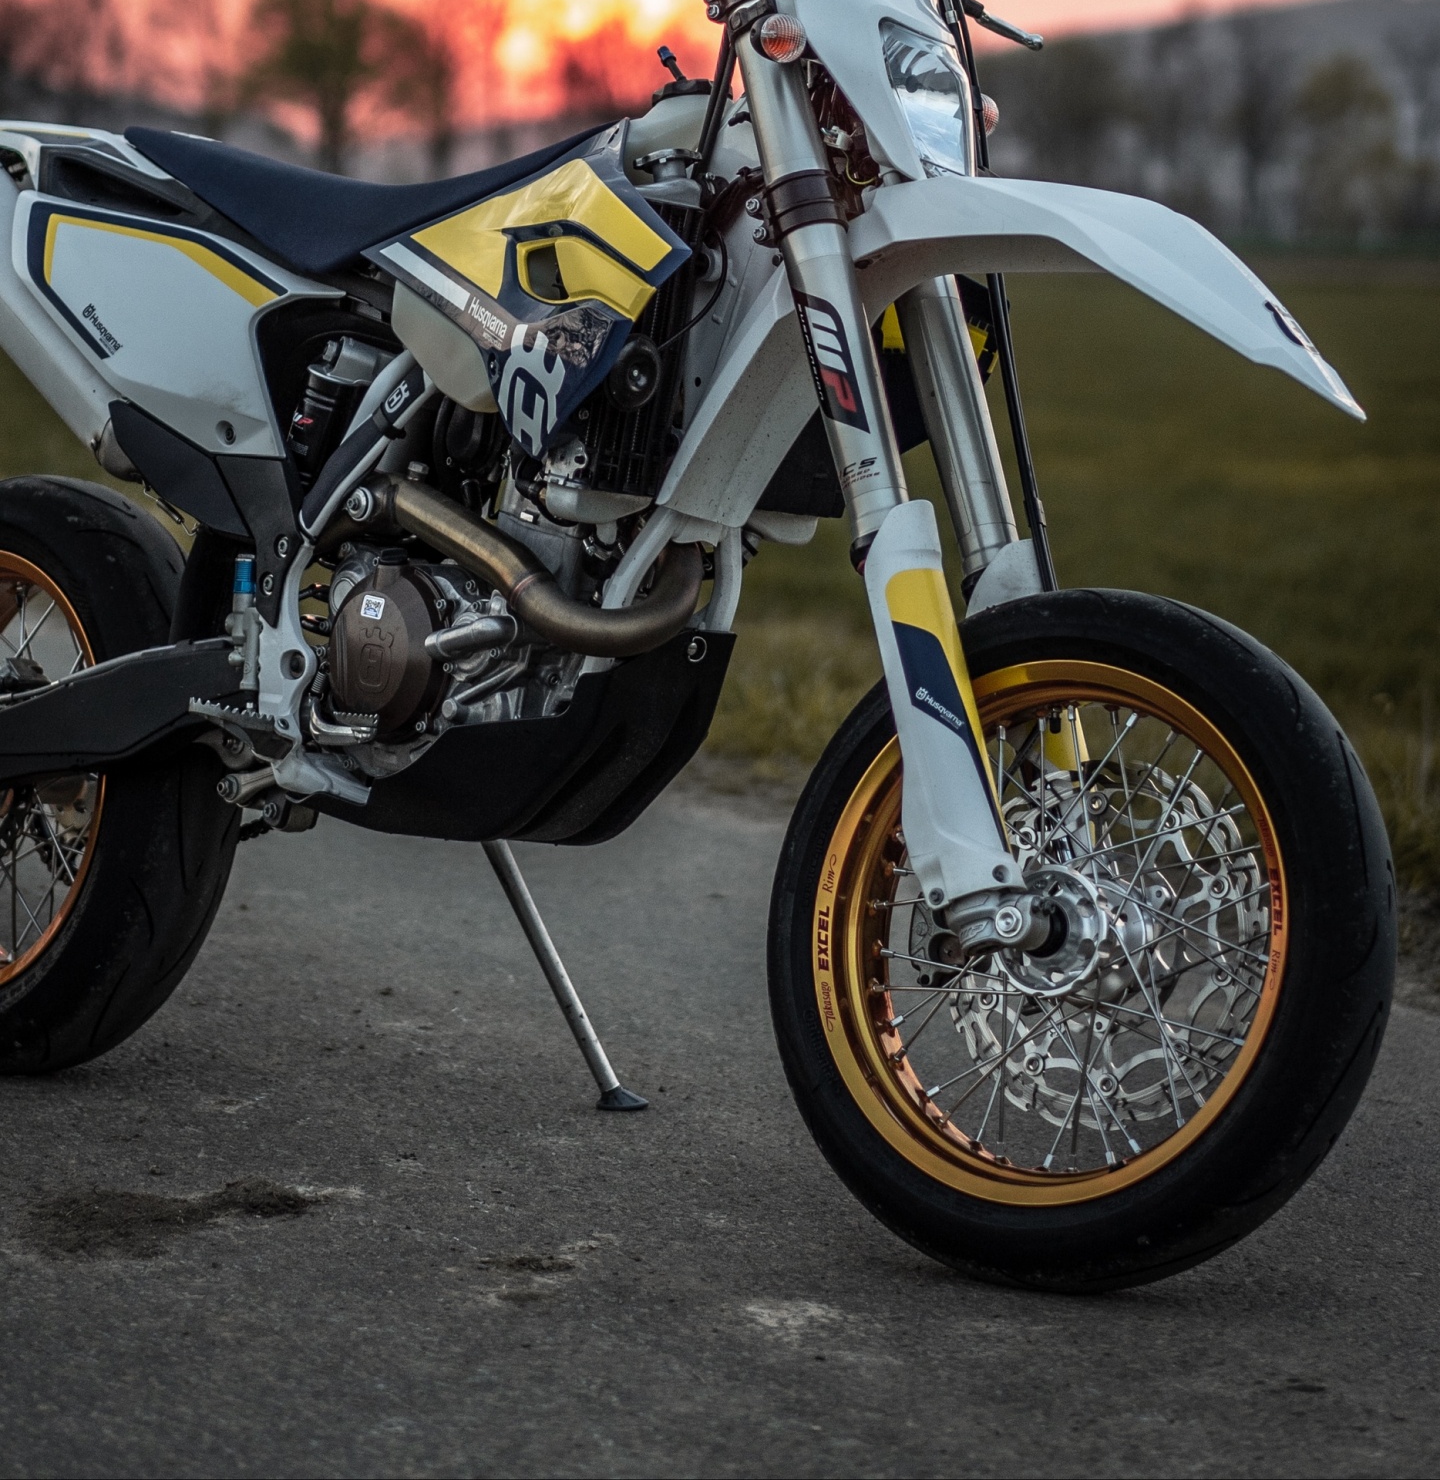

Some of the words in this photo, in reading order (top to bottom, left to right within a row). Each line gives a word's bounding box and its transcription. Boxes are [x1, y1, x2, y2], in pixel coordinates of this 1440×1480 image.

[89, 312, 121, 351] Husqvarna
[468, 296, 508, 338] Husqvarna
[804, 305, 857, 413] WP
[841, 457, 877, 477] CS
[924, 694, 962, 726] Husqvarna
[822, 853, 837, 893] Rim
[1268, 868, 1283, 935] EXCEL
[817, 905, 830, 971] EXCEL
[821, 981, 836, 1033] Takasago
